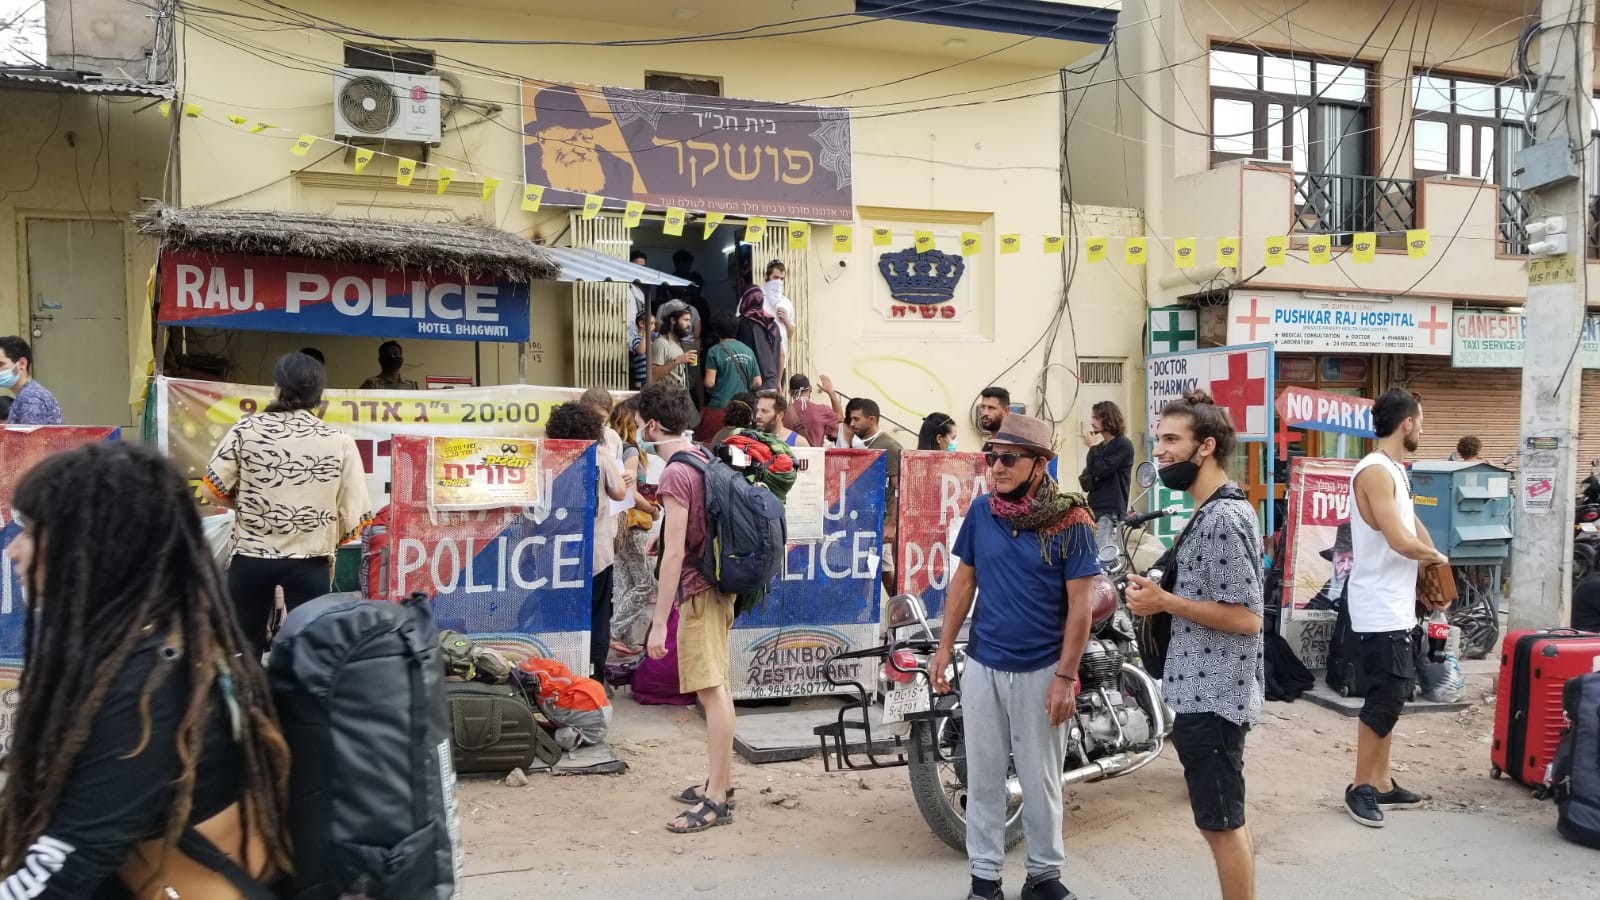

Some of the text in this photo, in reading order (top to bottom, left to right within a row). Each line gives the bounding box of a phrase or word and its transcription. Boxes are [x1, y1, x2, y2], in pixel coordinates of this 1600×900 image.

[412, 105, 426, 114] LG
[745, 116, 776, 134] בית
[651, 135, 814, 189] פושקר
[176, 264, 499, 322] RAJ. POLICE
[891, 304, 956, 319] משיח
[1275, 309, 1414, 327] PUSHKAR RAJ HOSPITAL
[418, 322, 509, 337] HOTEL BHAGWATI
[1456, 314, 1519, 339] GANESH
[1462, 340, 1479, 350] TAXI
[1482, 340, 1515, 350] SERVICE
[1154, 358, 1187, 376] DOCTOR
[1153, 378, 1198, 397] PHARMACY
[341, 400, 402, 422] אדר
[461, 402, 540, 423] 20:00
[1287, 392, 1376, 432] NO PARKI
[443, 462, 526, 485] פורים
[1312, 491, 1350, 520] שיח
[397, 533, 585, 597] POLICE
[781, 531, 877, 582] LICE
[747, 663, 861, 686] RESTAURANT
